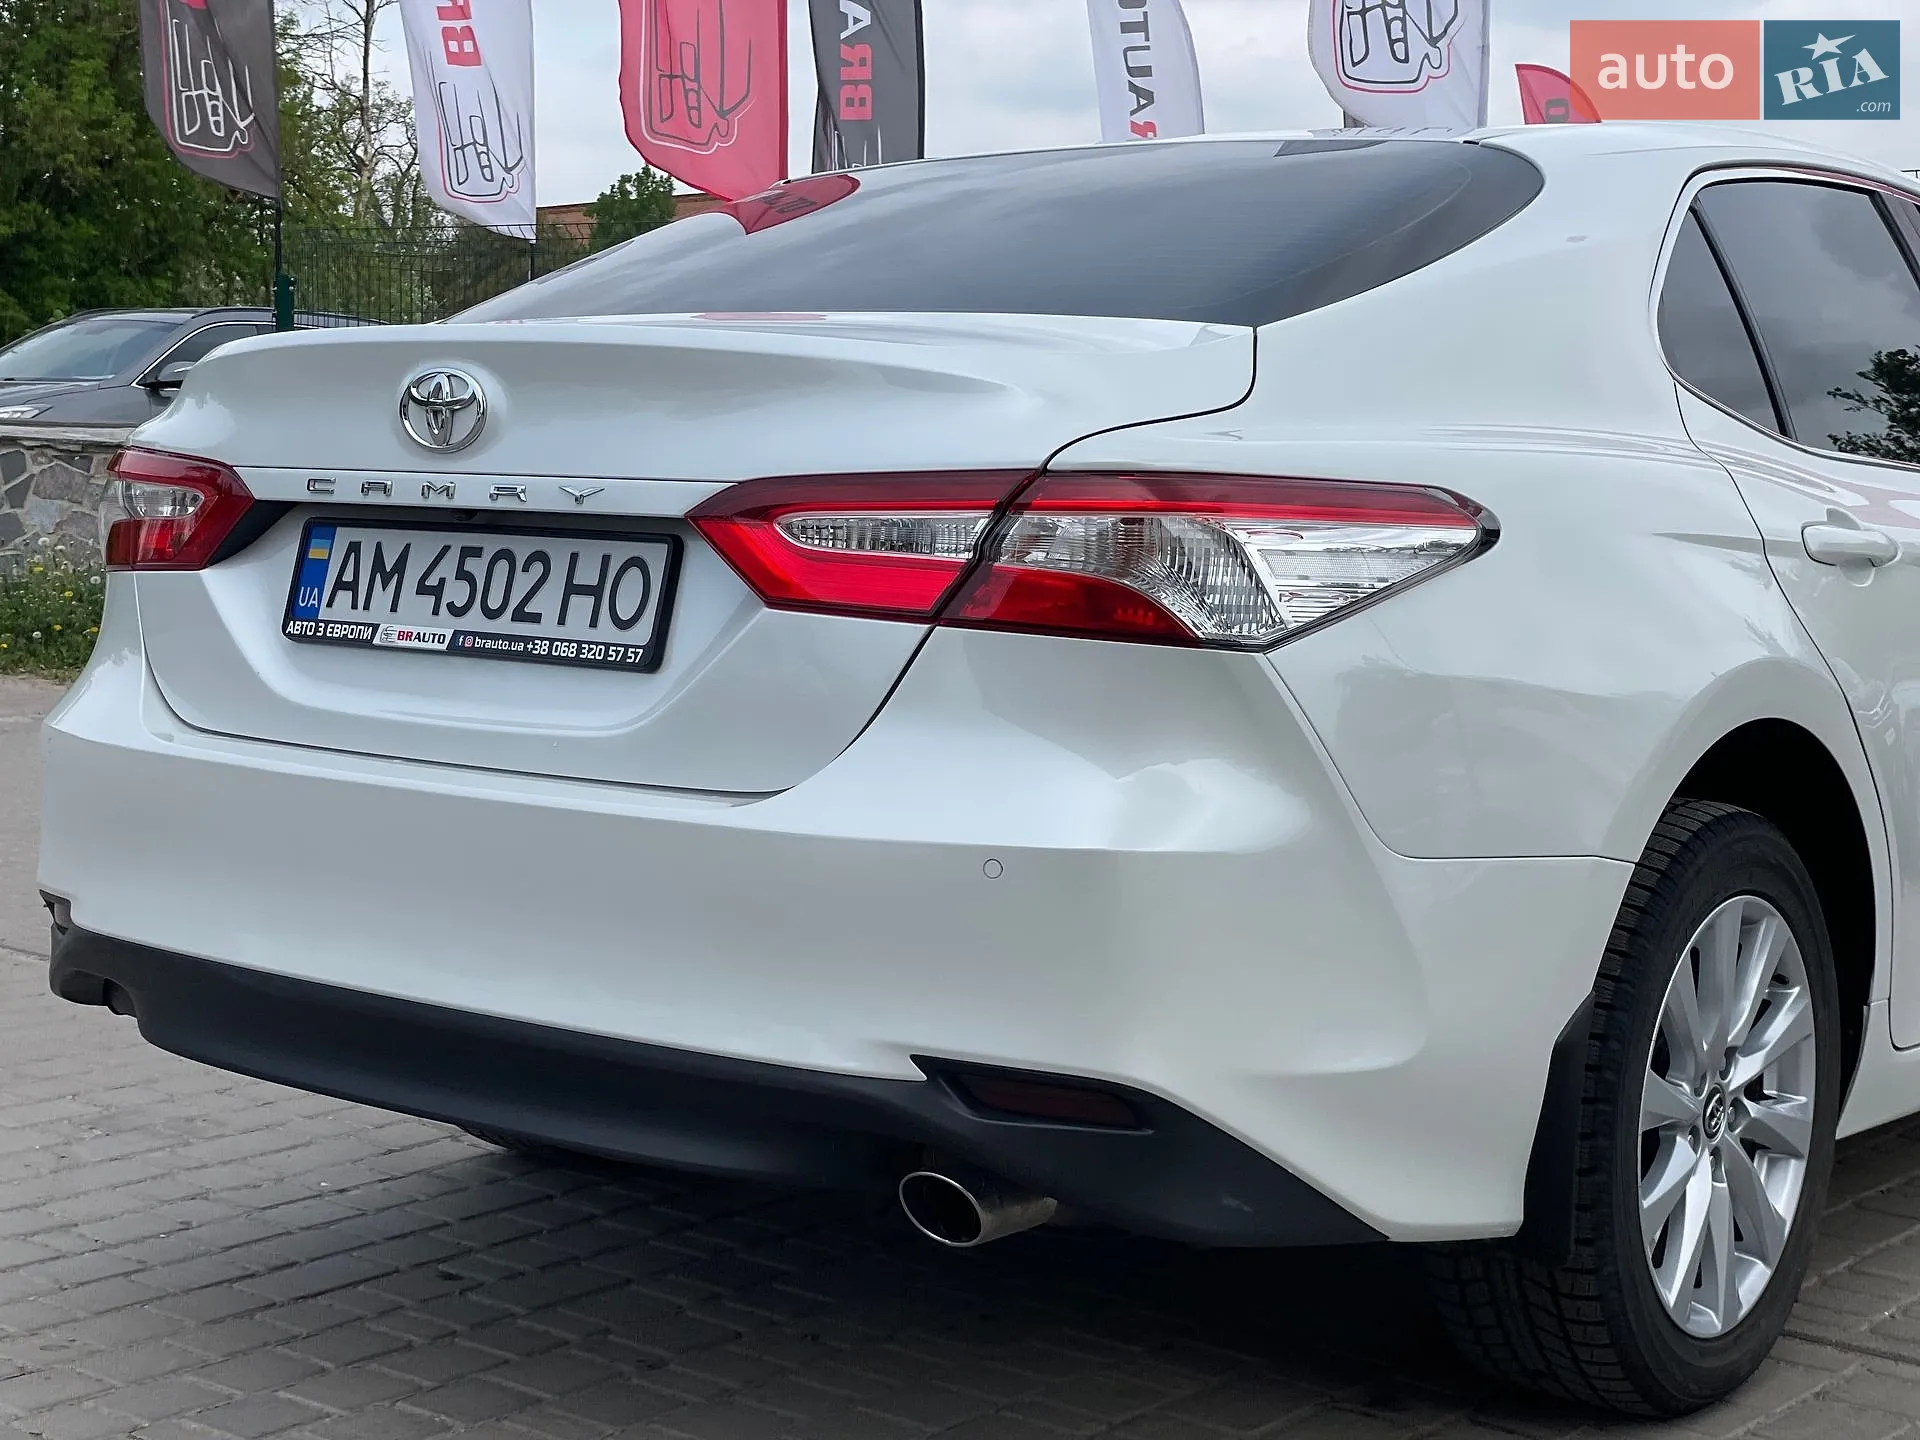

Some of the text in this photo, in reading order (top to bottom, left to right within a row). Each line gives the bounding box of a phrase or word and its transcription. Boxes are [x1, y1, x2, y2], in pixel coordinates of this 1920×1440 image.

[306, 477, 606, 504] CAMRY
[298, 586, 319, 609] UA
[325, 541, 651, 631] AM 4502 HO
[397, 630, 447, 645] BRAUTO
[474, 636, 524, 652] brauto.ua
[526, 640, 550, 655] +38
[552, 641, 577, 658] 068
[579, 644, 604, 660] 320
[607, 646, 625, 662] 57
[626, 648, 643, 663] 57
